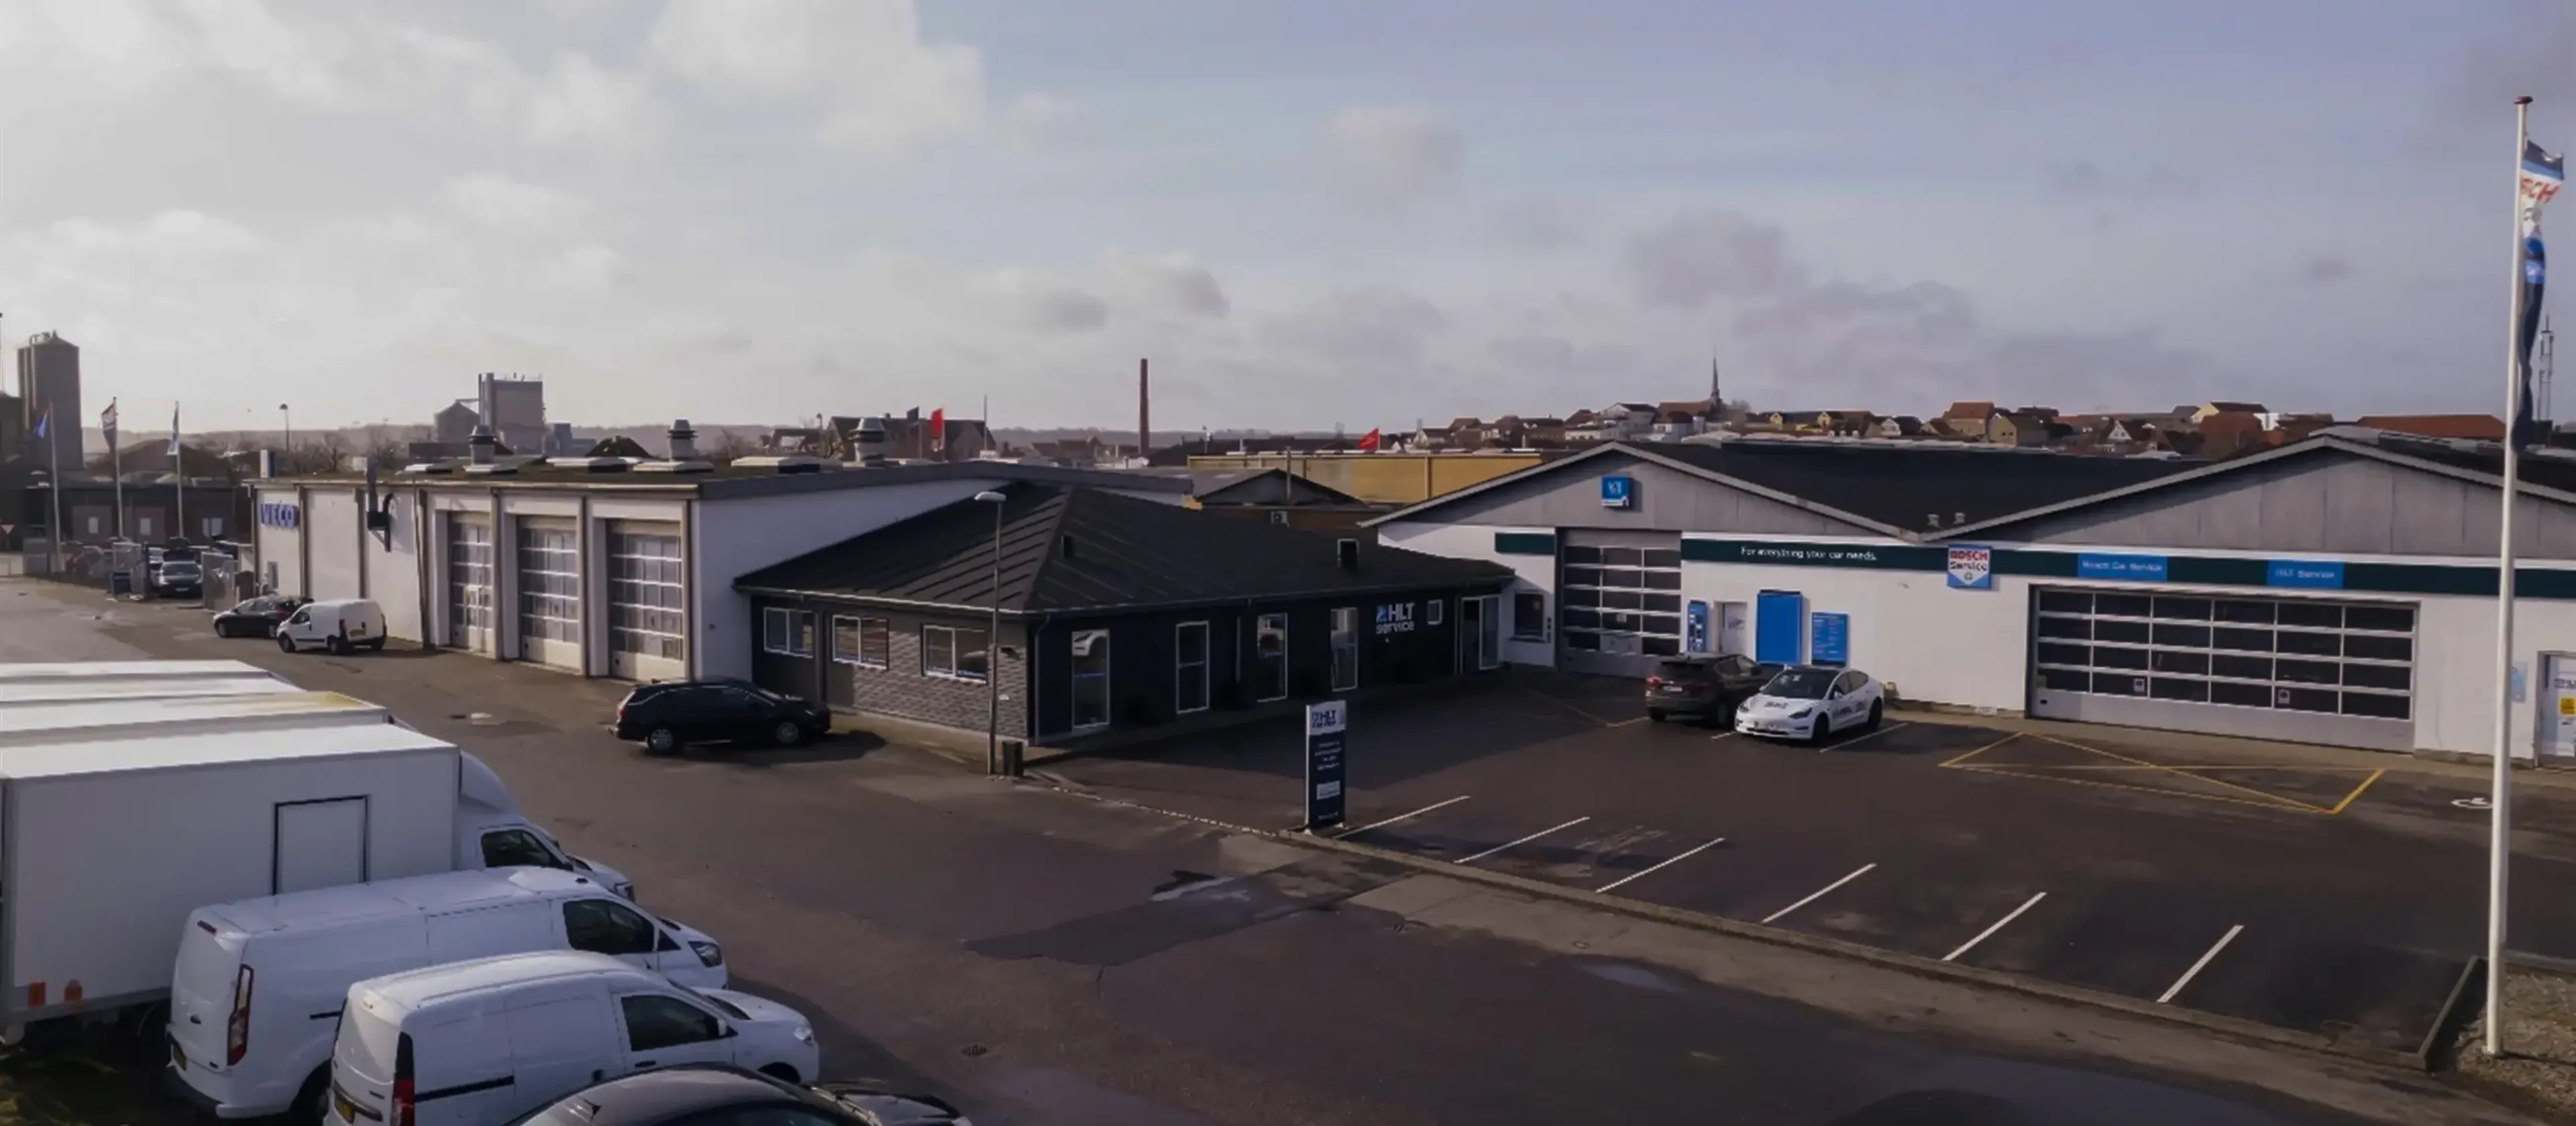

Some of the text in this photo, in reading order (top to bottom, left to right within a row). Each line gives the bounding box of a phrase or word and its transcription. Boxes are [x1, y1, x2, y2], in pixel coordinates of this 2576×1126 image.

[2520, 177, 2561, 204] SCH
[1741, 546, 1756, 556] For
[1758, 548, 1804, 559] everything
[1807, 550, 1825, 559] your
[1829, 551, 1844, 559] car
[1950, 550, 1988, 561] BOSCH
[1949, 561, 1987, 572] Service
[1388, 603, 1415, 622] HLT
[1376, 621, 1415, 634] service
